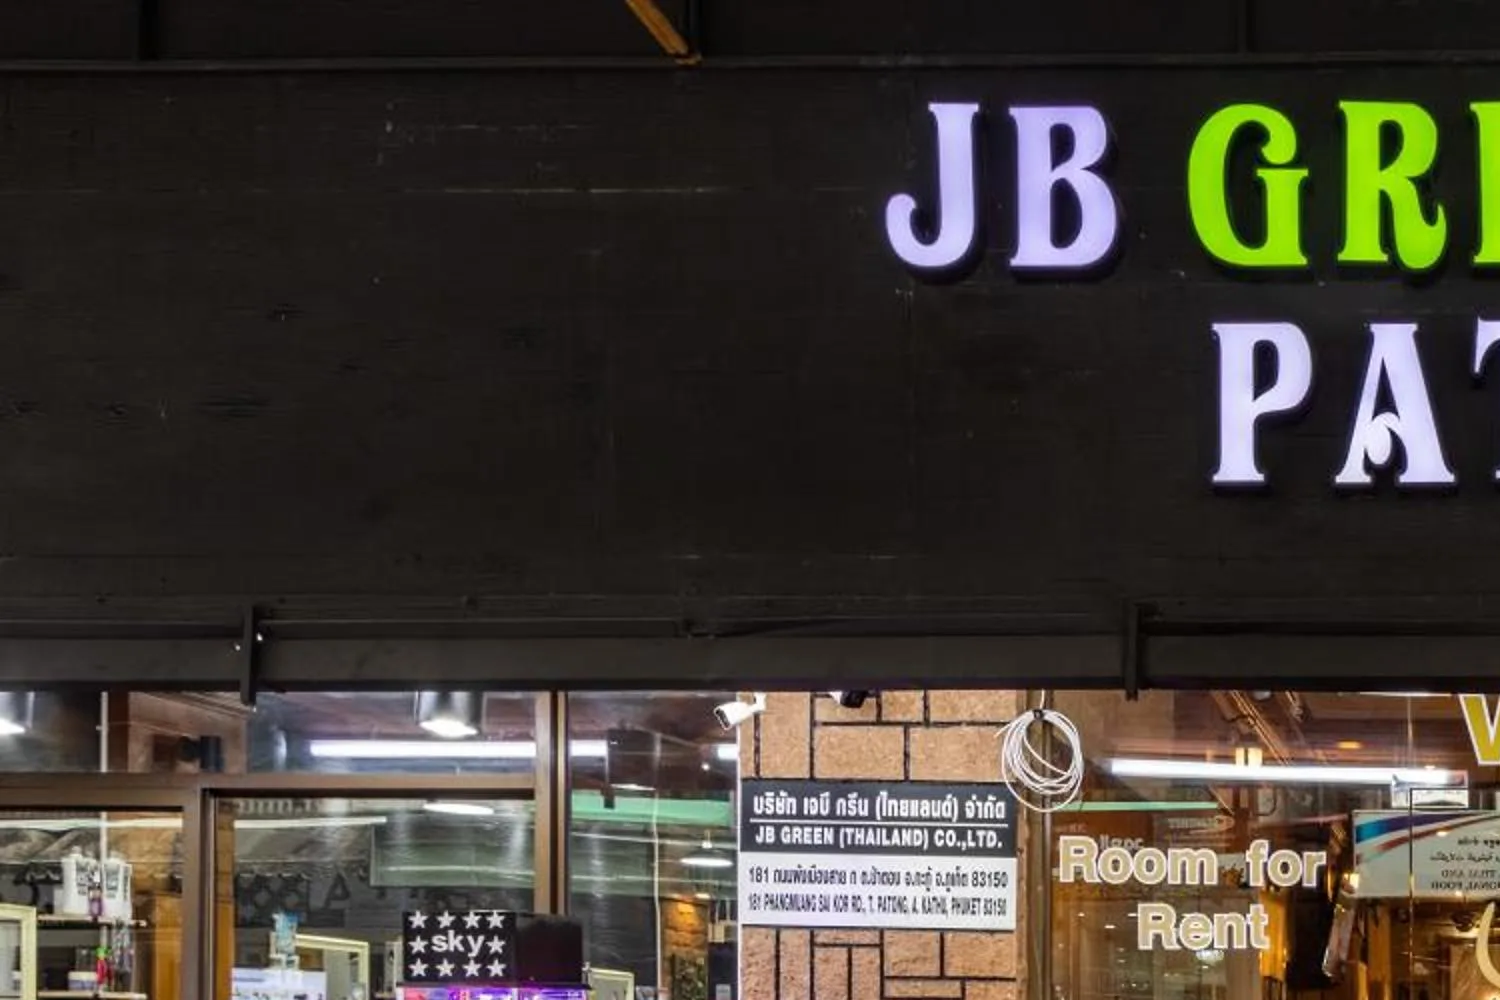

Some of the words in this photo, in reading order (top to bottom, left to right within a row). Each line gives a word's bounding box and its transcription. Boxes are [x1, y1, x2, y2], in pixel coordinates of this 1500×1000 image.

[885, 102, 1116, 268] JB
[755, 825, 776, 845] JB
[781, 825, 835, 845] GREEN
[839, 826, 929, 851] (THAILAND)
[749, 867, 770, 884] 181
[971, 871, 1009, 889] 83150
[1058, 835, 1219, 885] Room
[1246, 833, 1328, 888] for
[431, 929, 485, 957] sky
[1136, 902, 1270, 951] Rent
